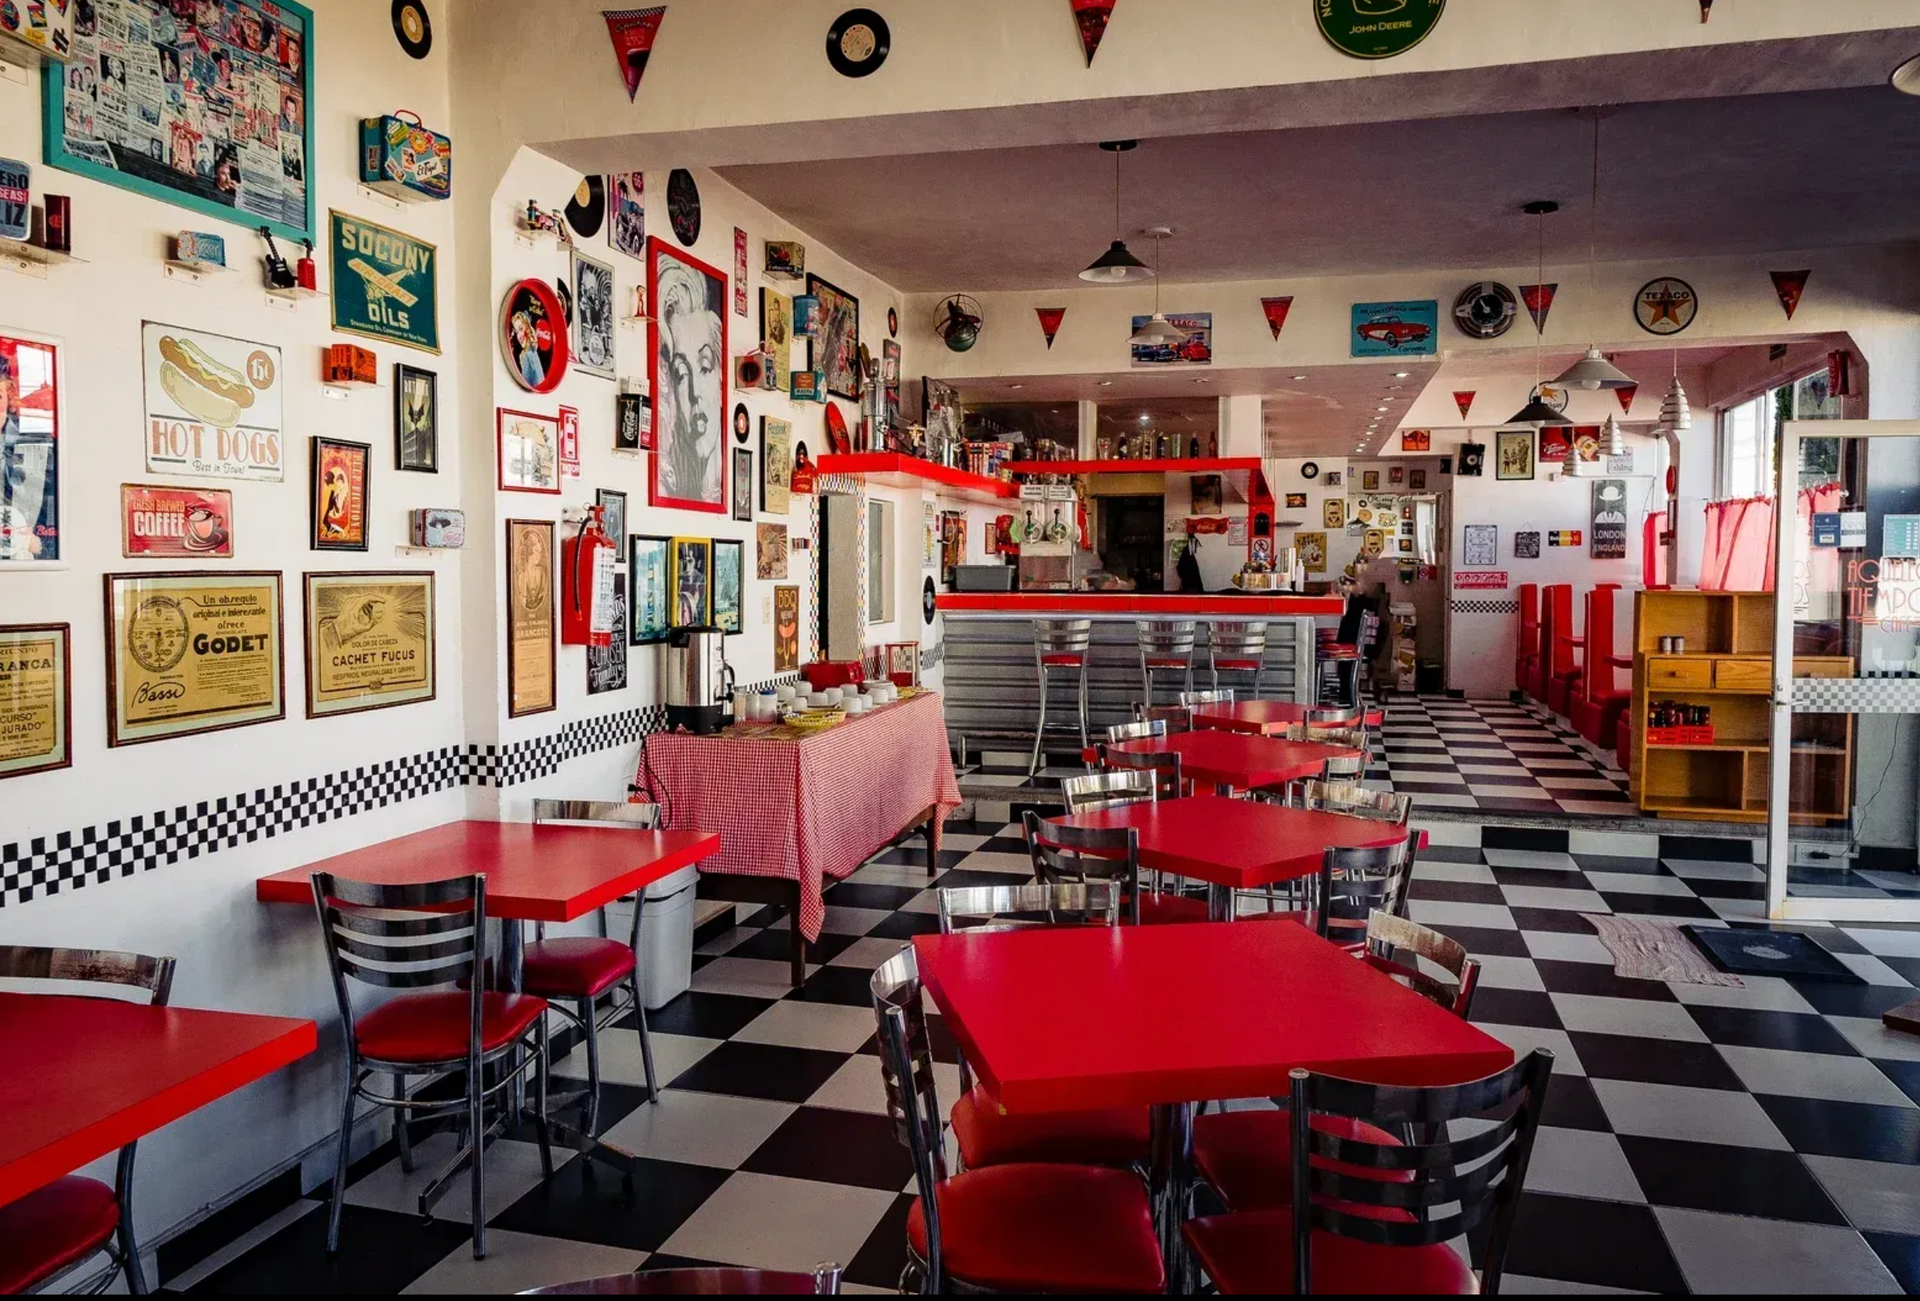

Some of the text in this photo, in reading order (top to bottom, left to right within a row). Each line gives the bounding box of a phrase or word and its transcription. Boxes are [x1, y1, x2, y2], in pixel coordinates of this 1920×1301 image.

[1349, 20, 1412, 35] JOHN DEERE
[342, 222, 430, 274] SOCONY
[1645, 291, 1690, 300] TEXACO
[367, 303, 410, 330] OILS
[152, 420, 280, 466] HOT DOGS
[192, 459, 212, 473] Best
[352, 454, 364, 487] PULP
[133, 511, 186, 537] COFFEE
[1594, 530, 1626, 539] LONDON
[1593, 544, 1626, 552] ENGLAND
[1847, 559, 1920, 583] AQUELL
[203, 594, 258, 605] Un obsequio
[778, 590, 797, 613] BBQ
[193, 608, 220, 621] original
[217, 620, 245, 630] ofrece
[516, 627, 549, 639] BRANCATO
[193, 633, 269, 655] GODET
[351, 641, 370, 649] DOLOR
[379, 638, 398, 646] CABEZA
[332, 652, 377, 667] CACHET
[381, 649, 416, 663] FUCUS
